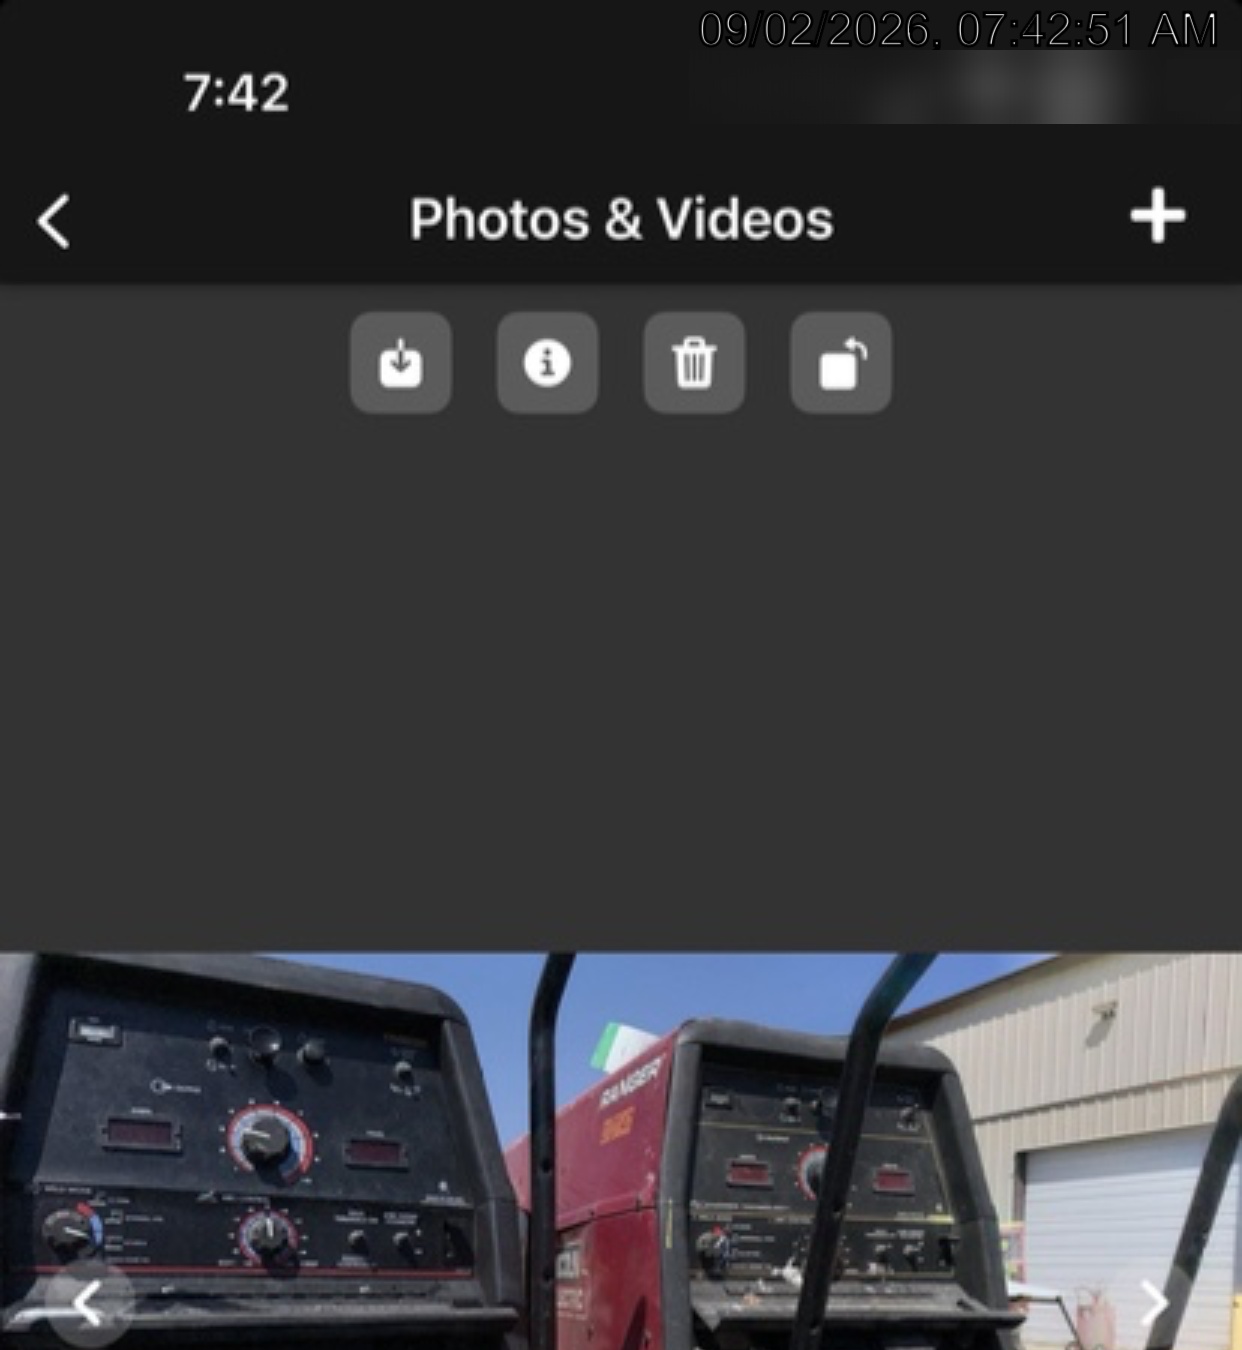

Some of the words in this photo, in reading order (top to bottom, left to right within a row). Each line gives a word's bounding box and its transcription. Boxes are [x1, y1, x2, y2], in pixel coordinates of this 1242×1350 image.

[183, 72, 290, 113] 7:42
[411, 195, 590, 242] Photos
[604, 195, 644, 242] &
[656, 195, 835, 242] Videos
